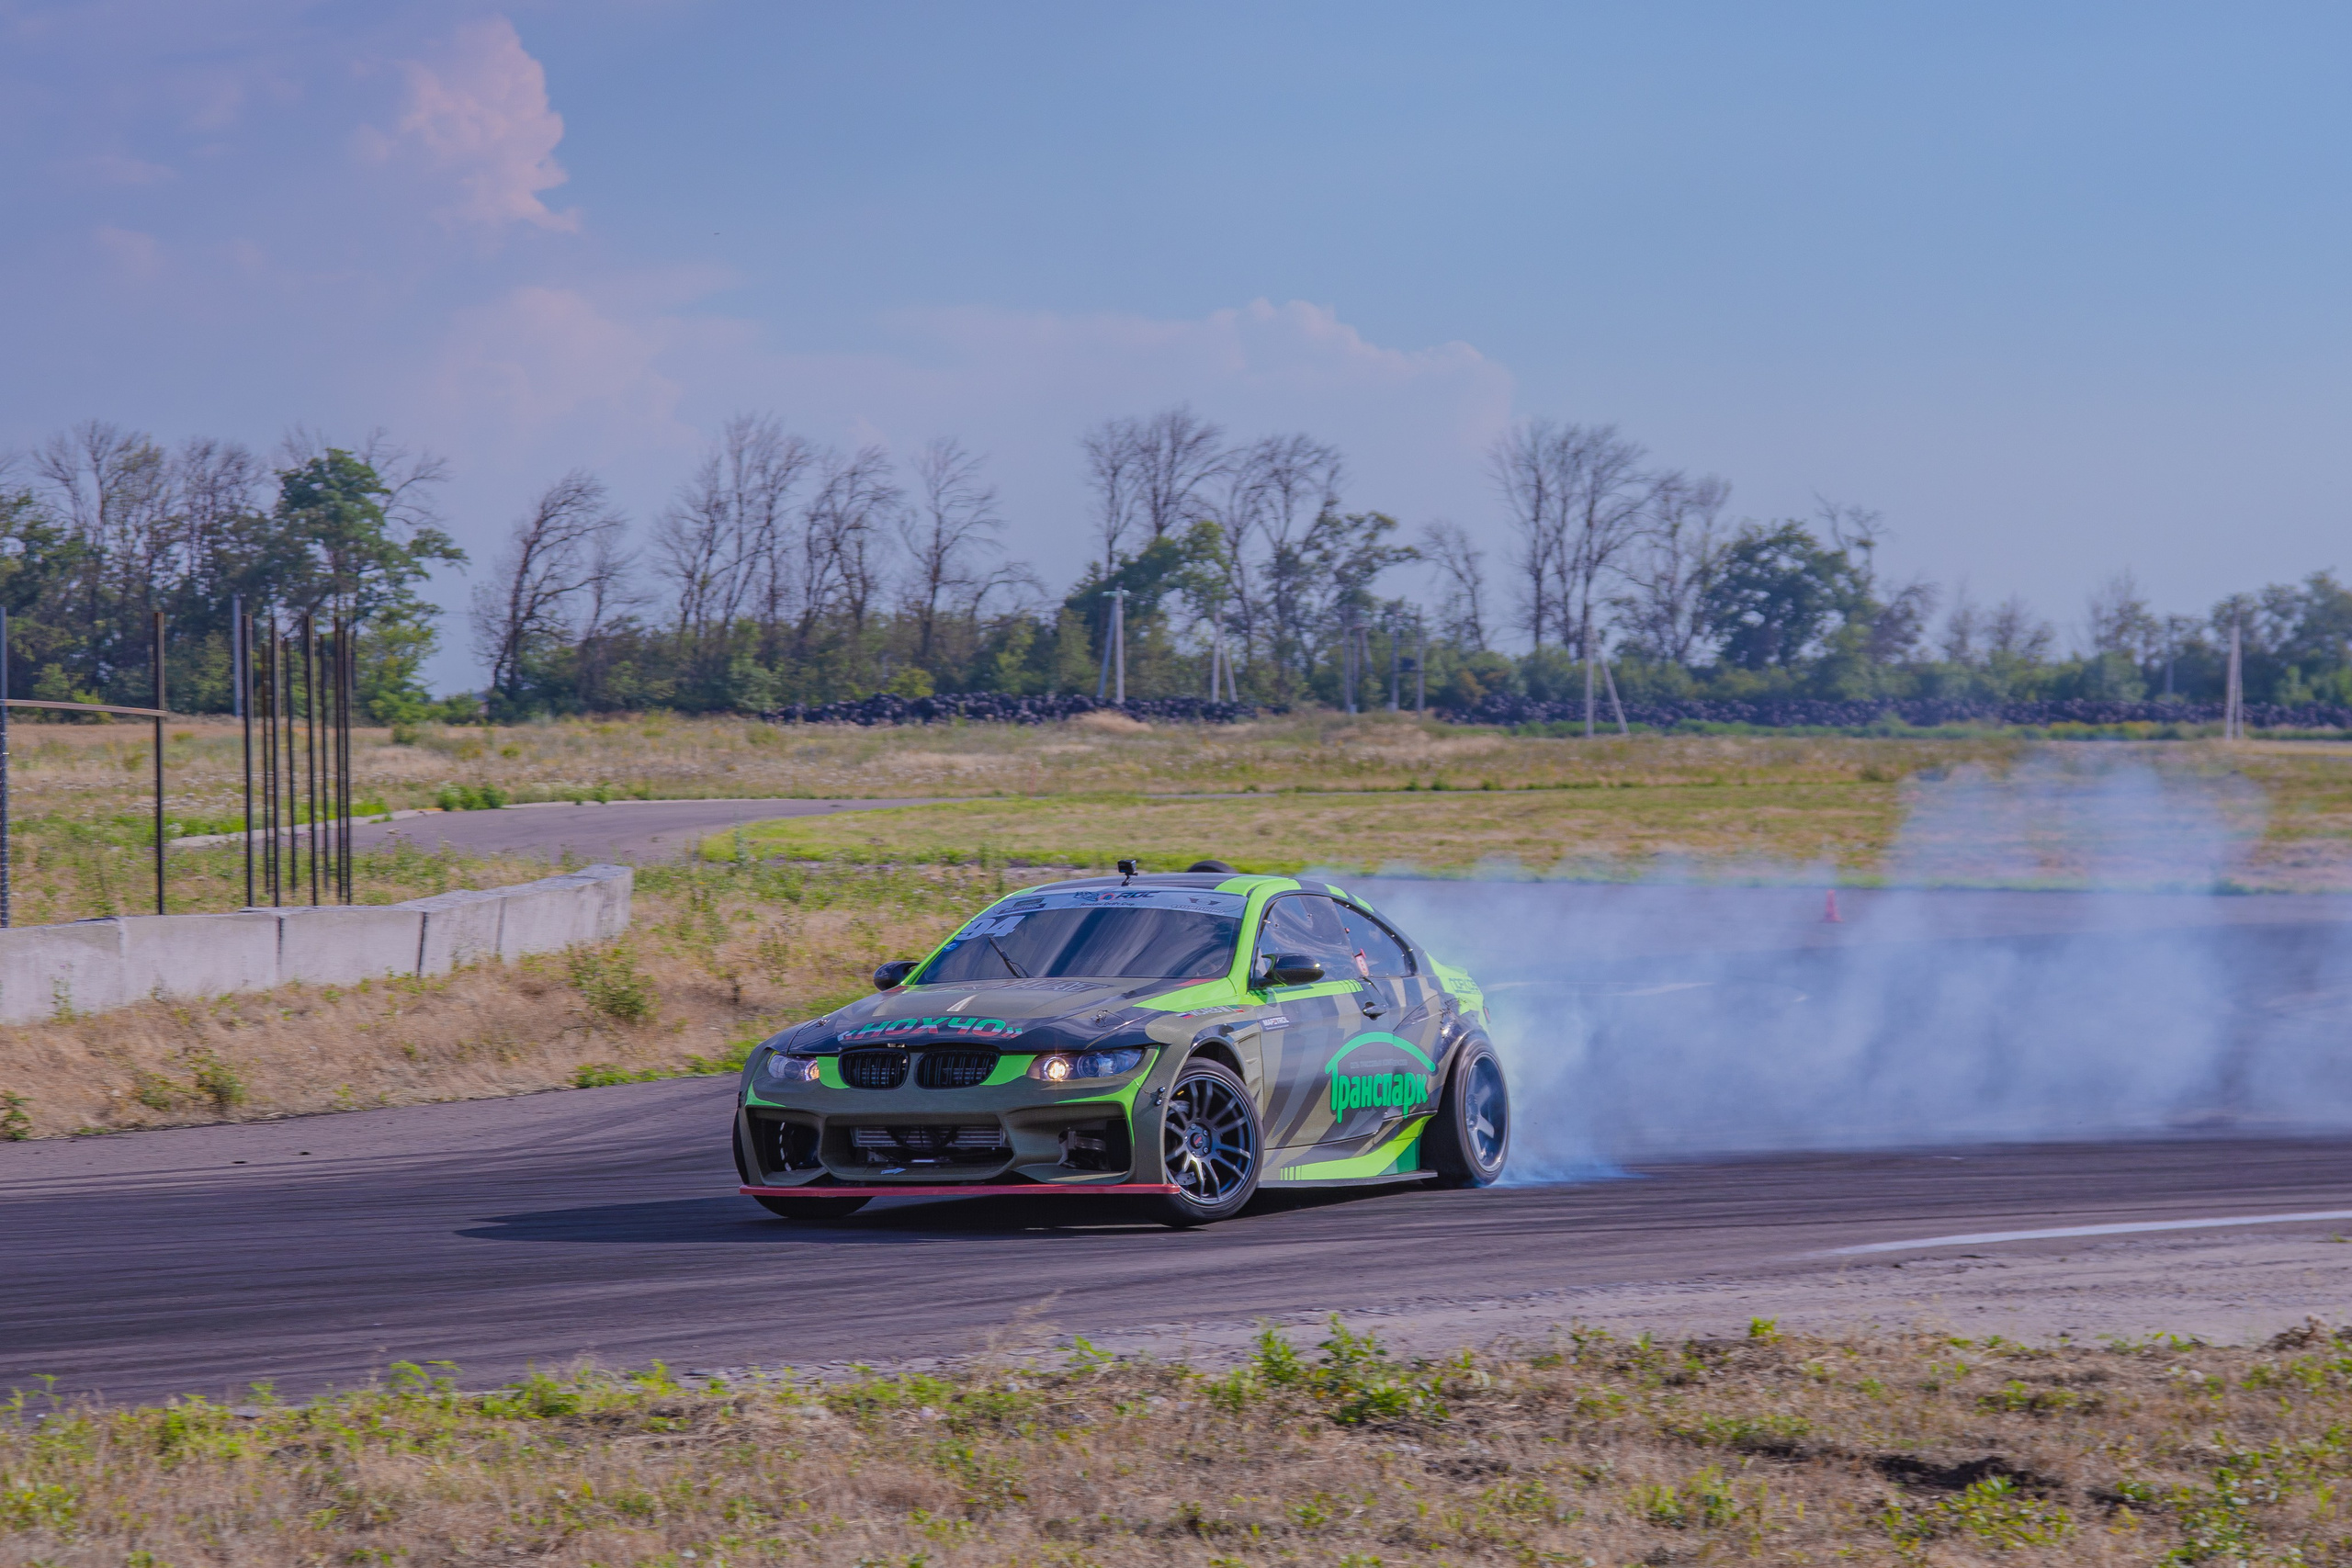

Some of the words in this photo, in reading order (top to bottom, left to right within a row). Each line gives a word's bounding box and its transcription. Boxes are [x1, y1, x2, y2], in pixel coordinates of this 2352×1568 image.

[1114, 891, 1160, 899] RDC
[954, 915, 1026, 941] 94
[1329, 1066, 1430, 1123] Транспарк
